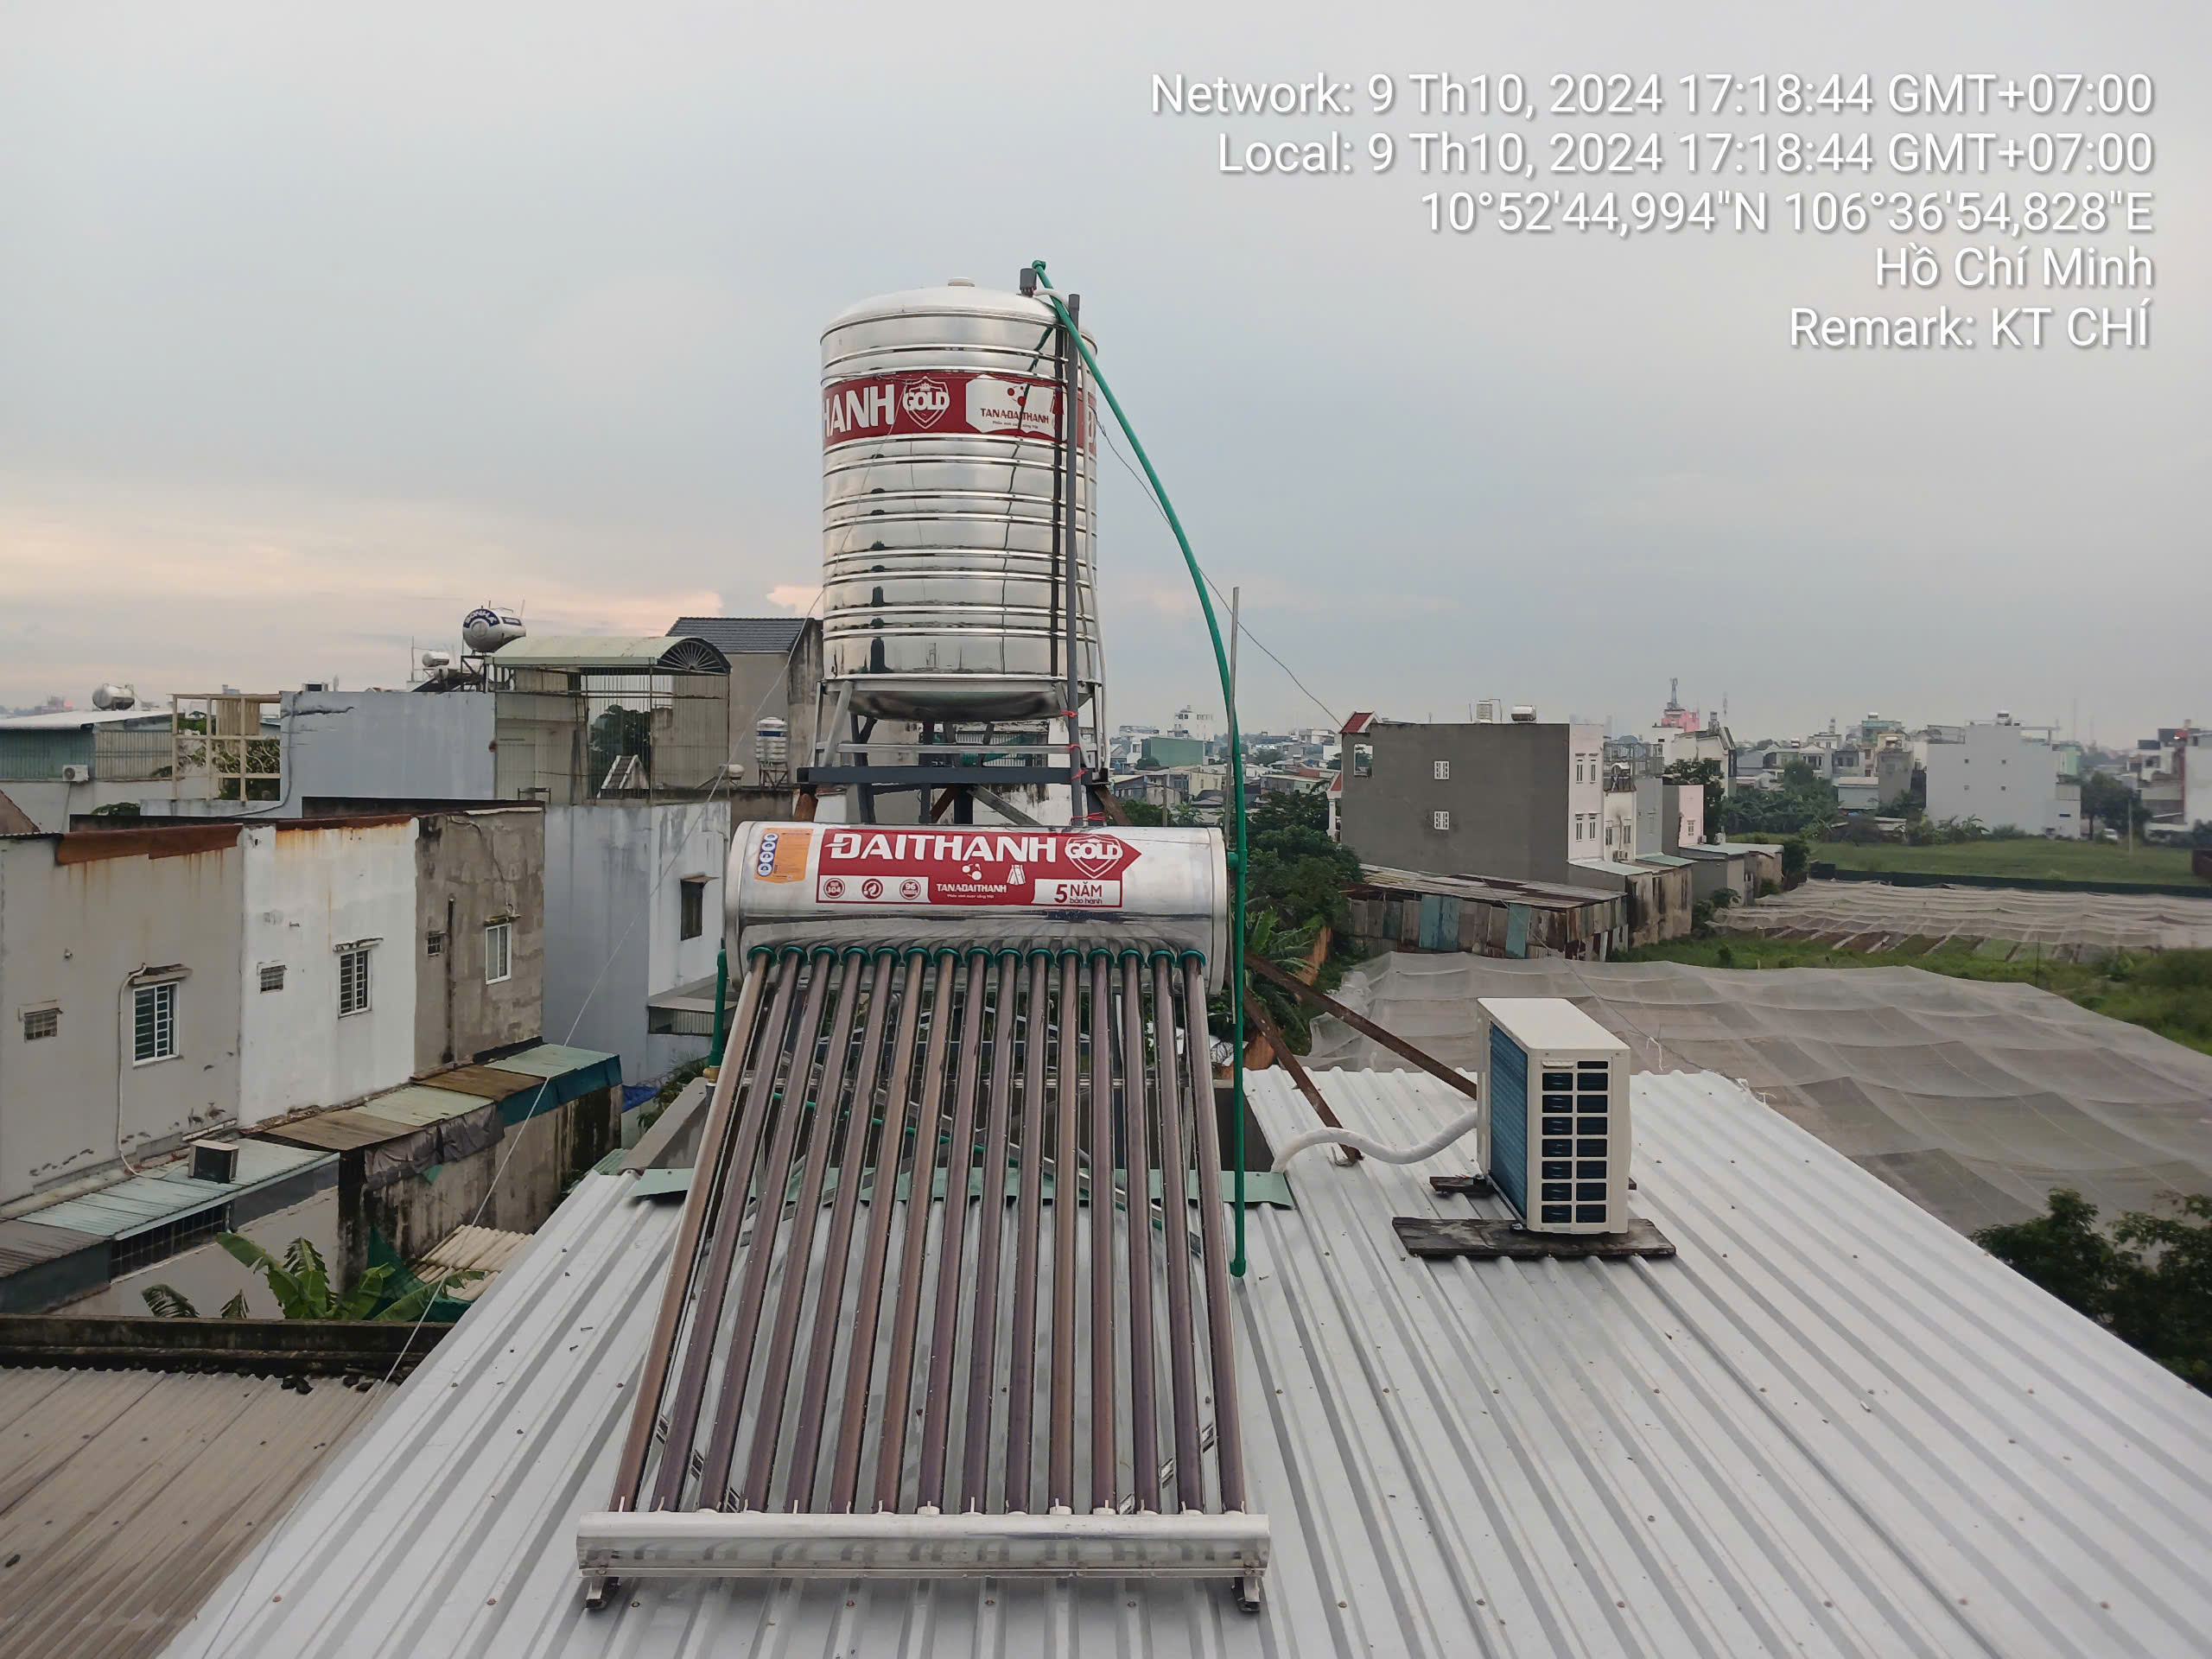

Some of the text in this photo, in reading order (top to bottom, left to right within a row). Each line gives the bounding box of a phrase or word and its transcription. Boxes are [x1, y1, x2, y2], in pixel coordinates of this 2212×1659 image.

[903, 391, 950, 411] GOLD
[1065, 842, 1123, 861] GOLD
[1053, 880, 1103, 904] 5 NĂM
